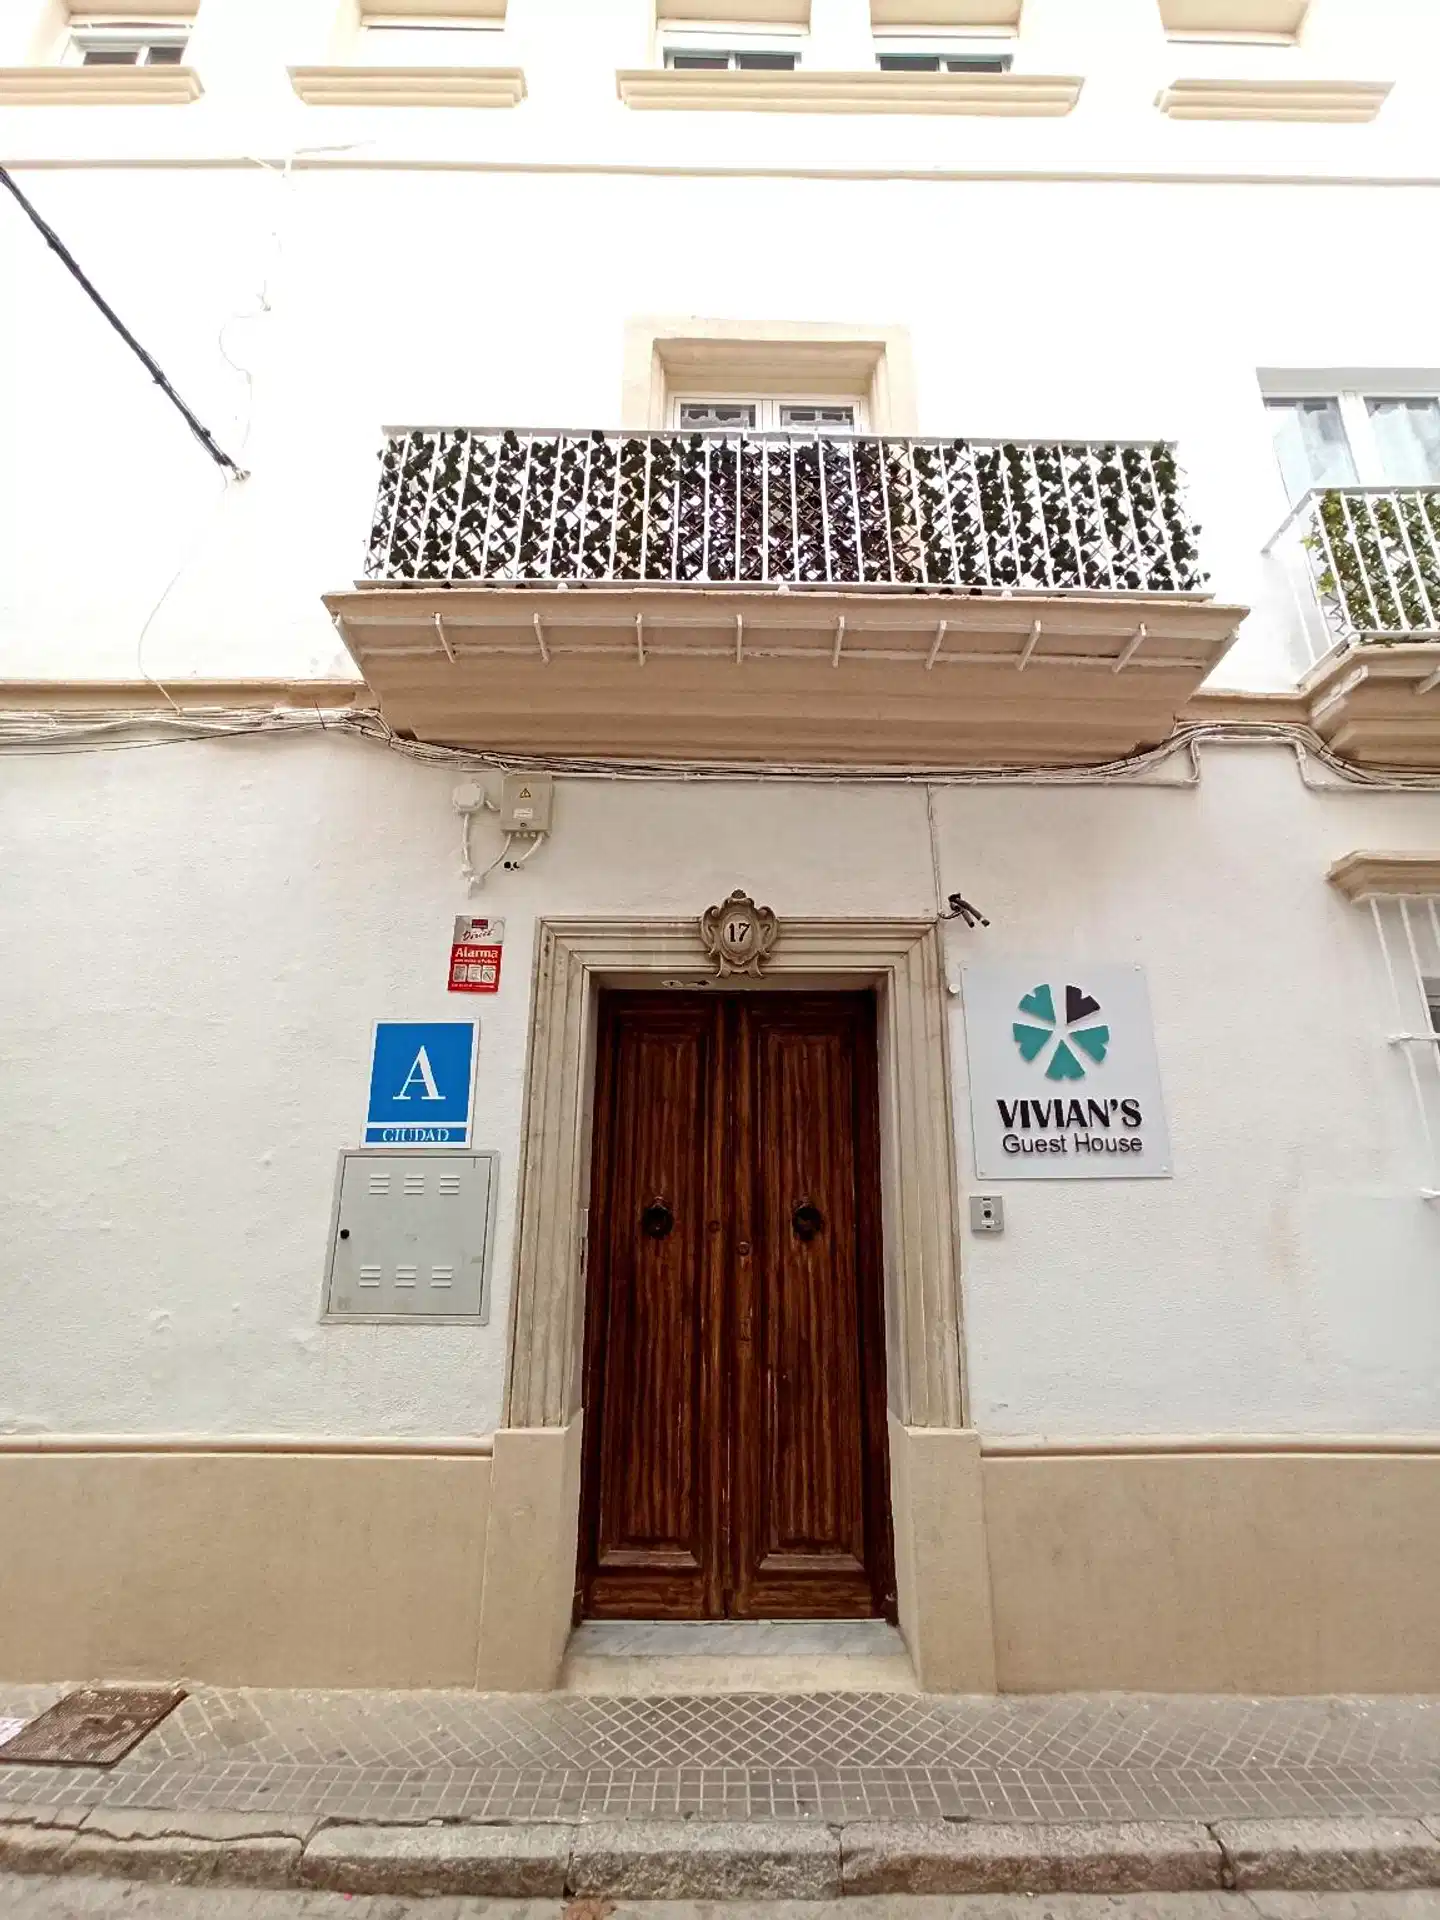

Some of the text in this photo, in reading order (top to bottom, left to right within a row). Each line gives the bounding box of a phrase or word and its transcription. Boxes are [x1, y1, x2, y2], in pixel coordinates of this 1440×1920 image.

[728, 922, 751, 943] 17
[455, 946, 499, 958] Alarma
[392, 1045, 446, 1100] A
[996, 1098, 1143, 1128] VIVIAN'S
[382, 1128, 450, 1142] CIUDAD
[1002, 1133, 1143, 1154] Guest House
